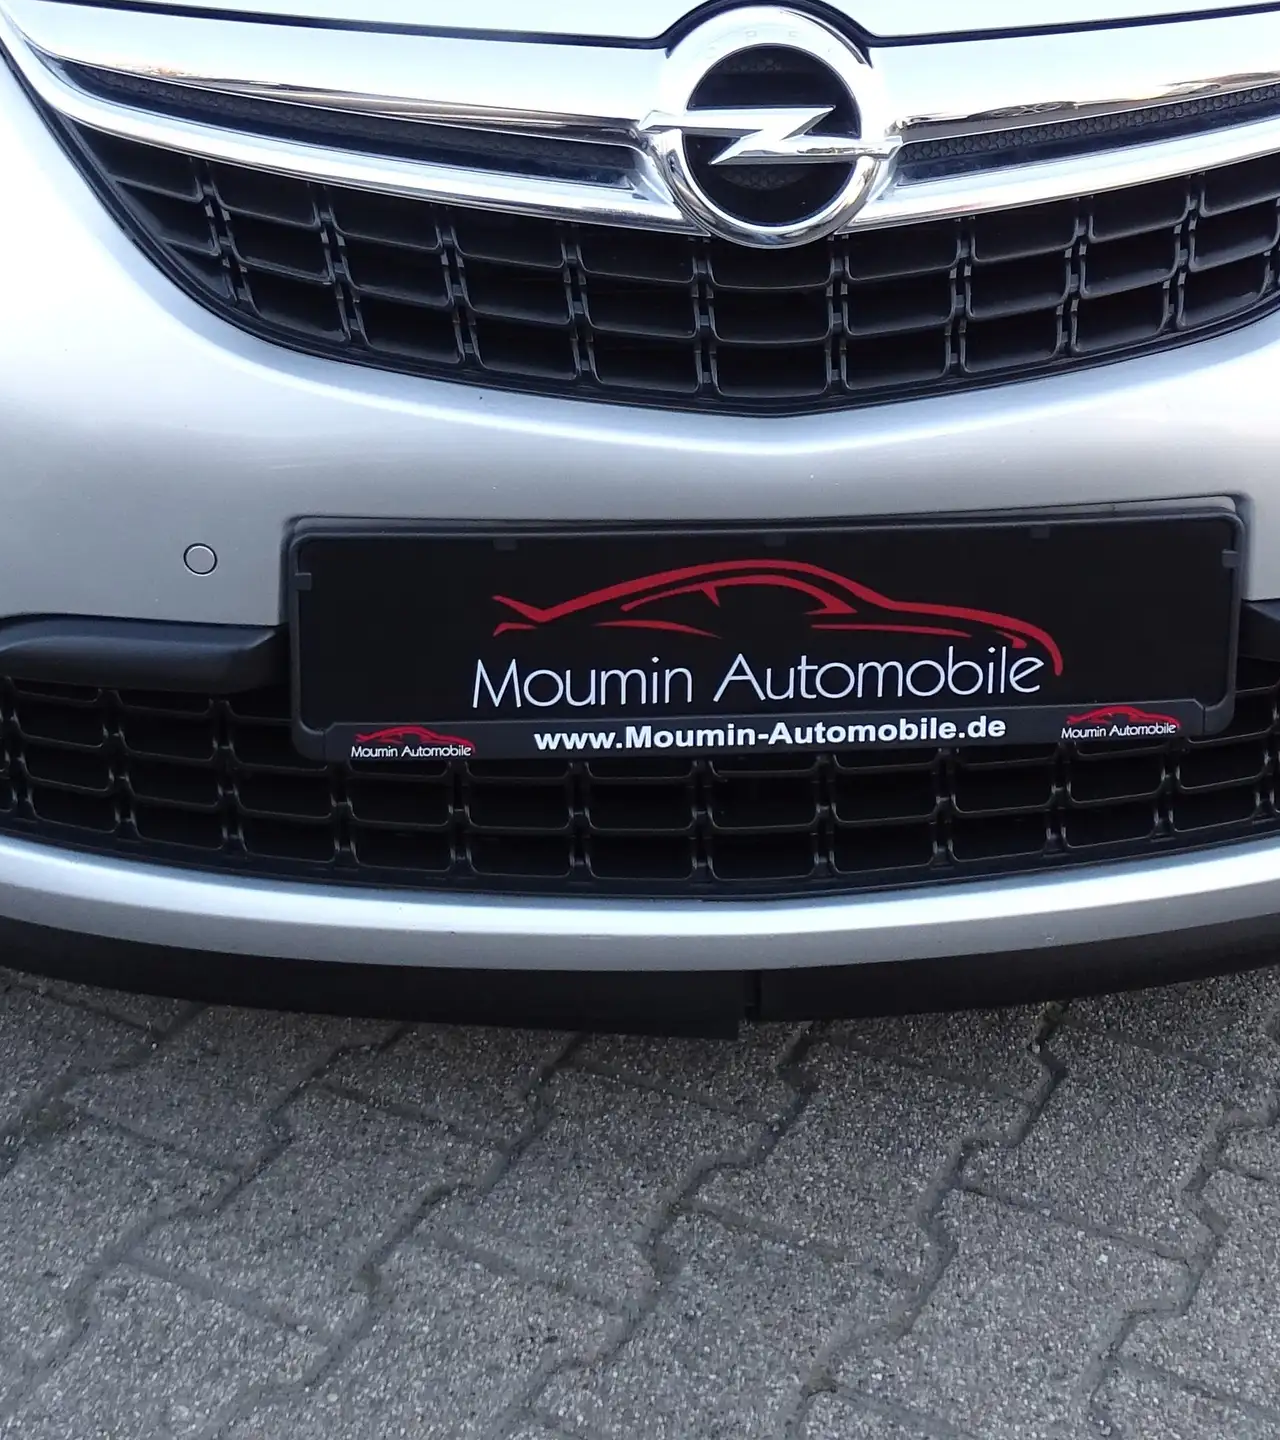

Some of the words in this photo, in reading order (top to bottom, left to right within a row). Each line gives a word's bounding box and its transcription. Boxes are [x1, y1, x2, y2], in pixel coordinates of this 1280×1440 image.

[471, 655, 694, 710] Moumin
[712, 644, 1046, 703] Automobile
[533, 715, 1007, 753] www.Moumin-Automobile.de
[1061, 725, 1107, 739] Moumin
[1108, 722, 1177, 737] Automobile
[350, 745, 398, 758] Moumin
[400, 744, 472, 757] Automobile
